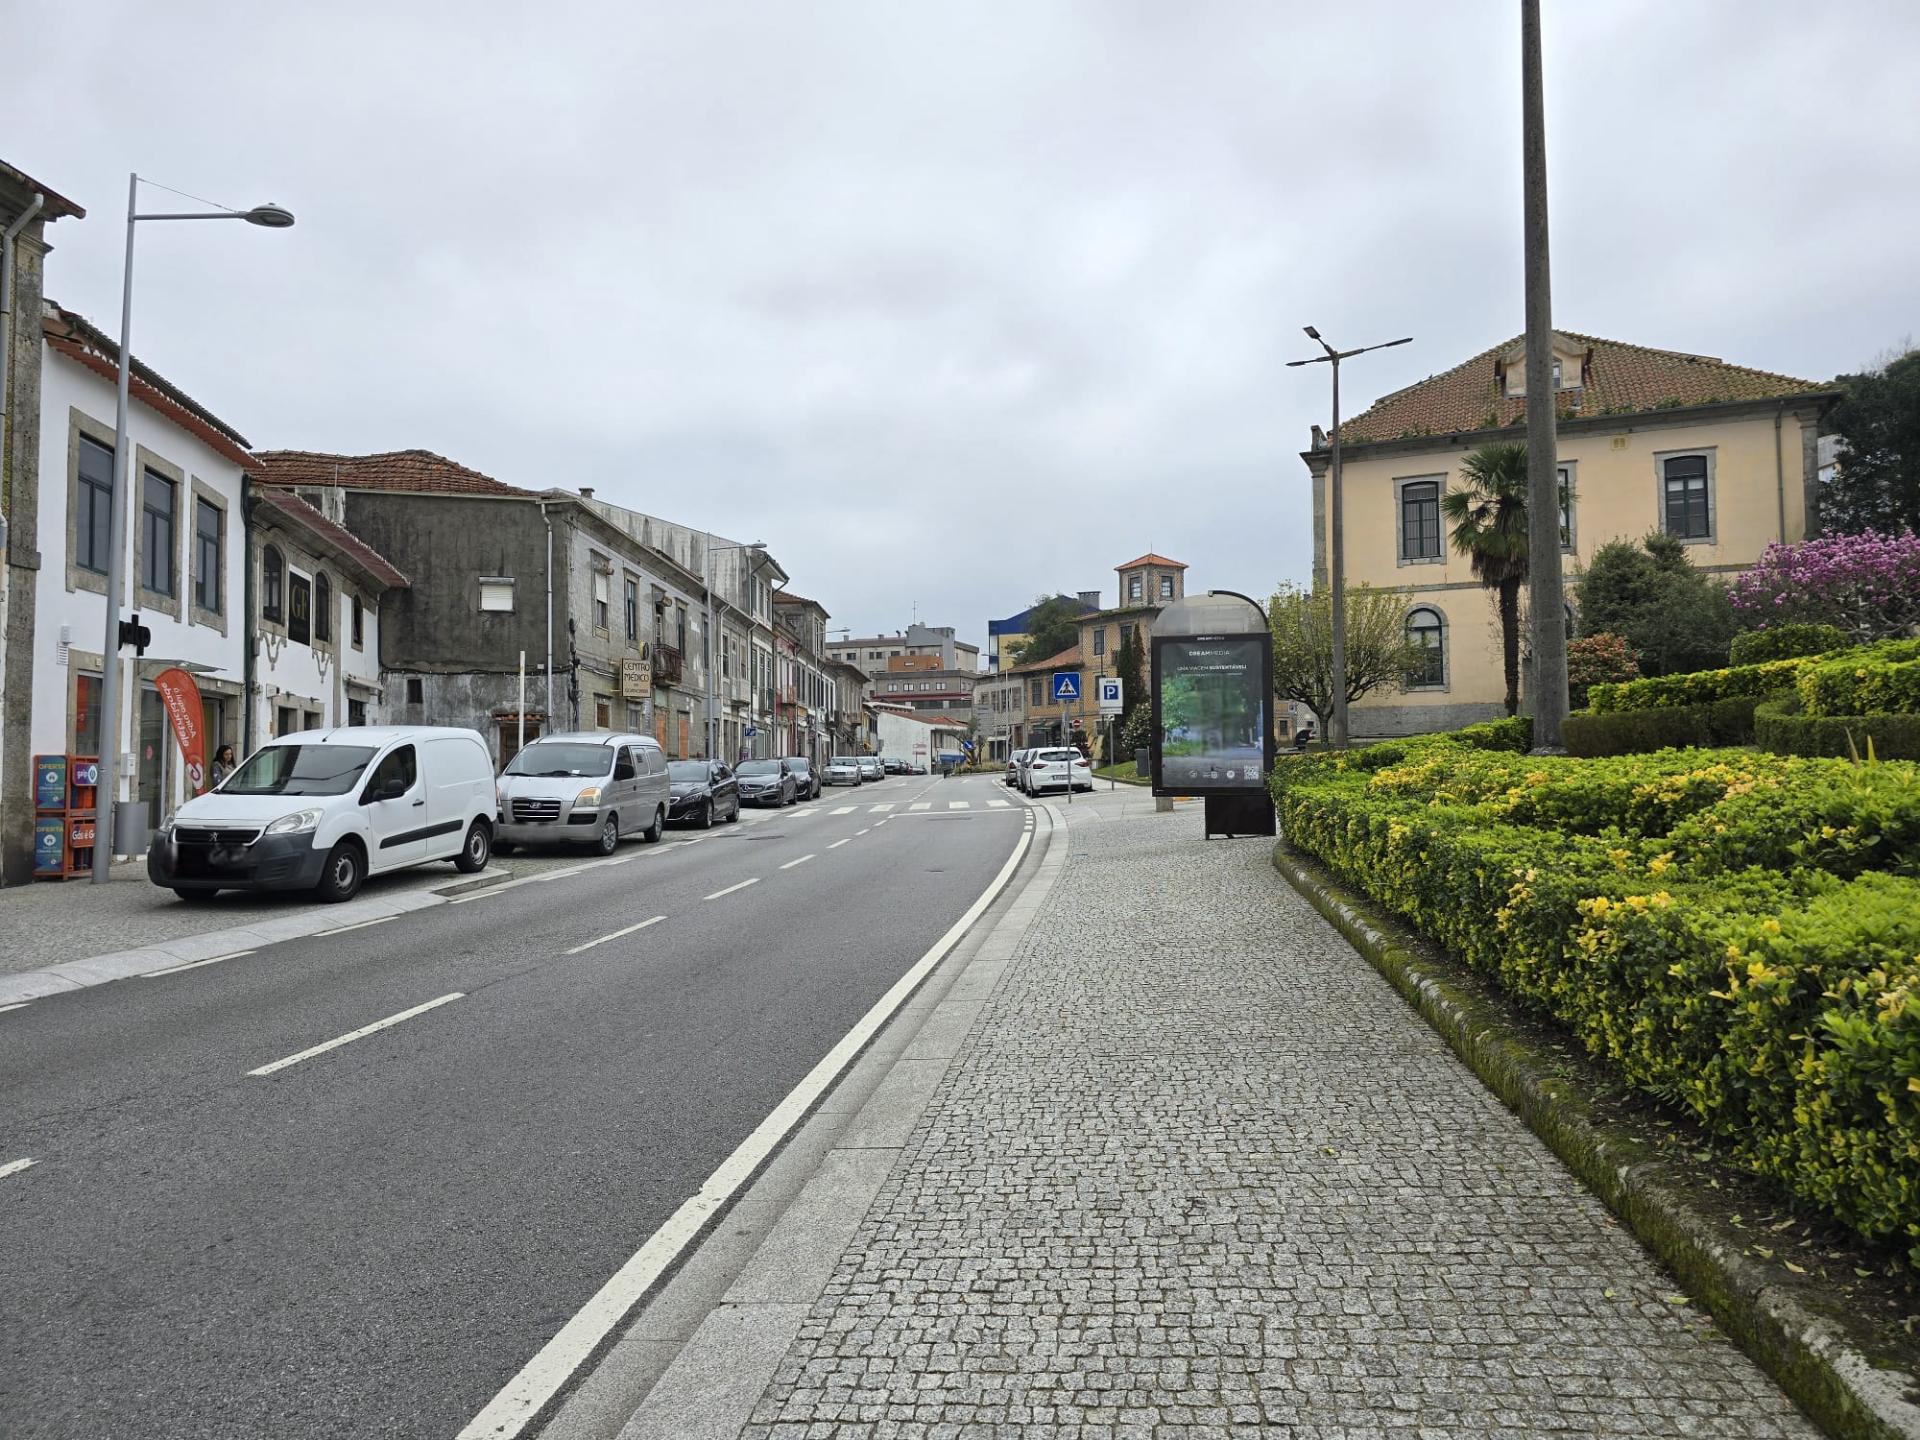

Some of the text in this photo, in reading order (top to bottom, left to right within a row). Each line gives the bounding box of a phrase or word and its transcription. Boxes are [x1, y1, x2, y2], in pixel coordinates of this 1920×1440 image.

[624, 662, 650, 671] CENTRO
[624, 672, 649, 682] MÉDICO
[1107, 686, 1116, 699] P
